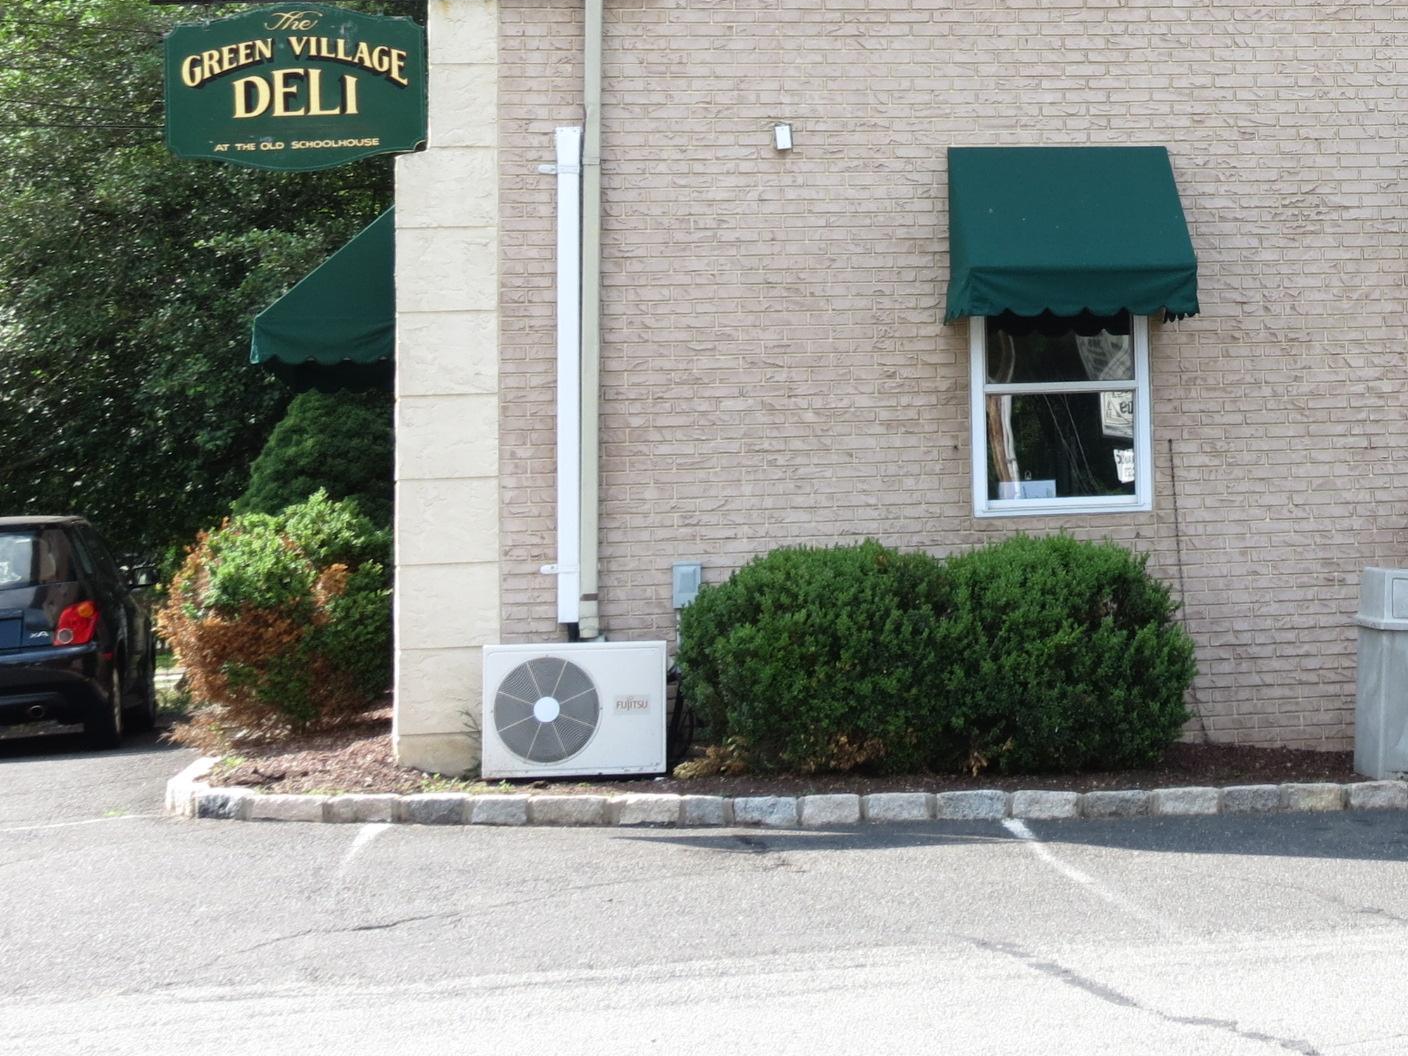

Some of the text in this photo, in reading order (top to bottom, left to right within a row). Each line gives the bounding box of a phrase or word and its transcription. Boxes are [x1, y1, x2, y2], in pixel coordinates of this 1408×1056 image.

[264, 10, 323, 31] The
[181, 36, 408, 87] GREEN VILLAGE
[232, 68, 359, 119] DELI
[214, 138, 380, 152] AT THE OLD SCHOOLHOUSE
[616, 699, 648, 711] FUJITSU
